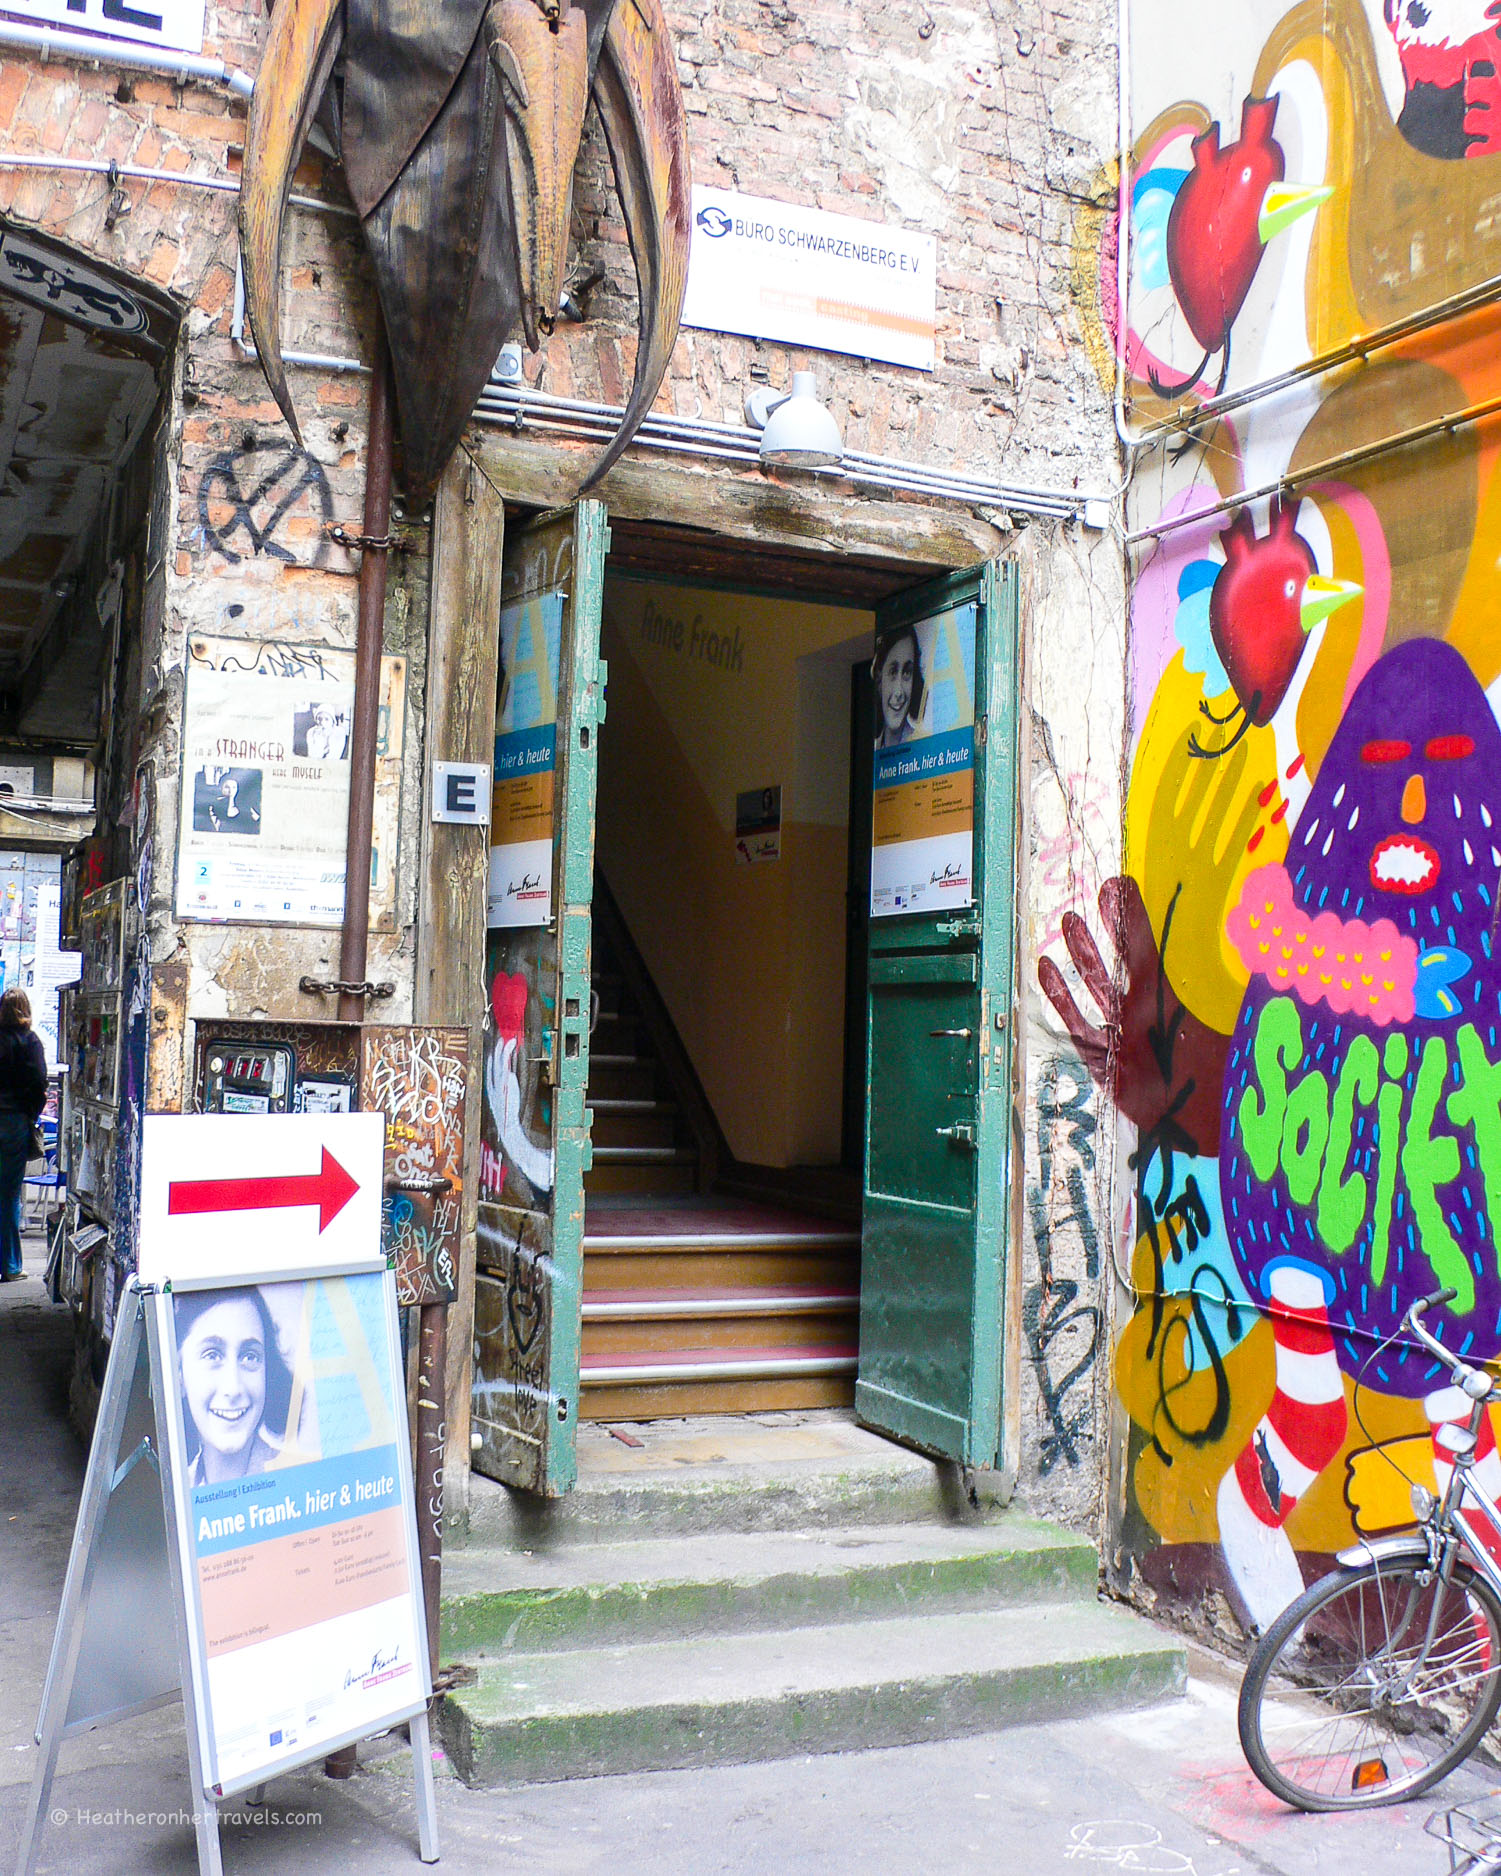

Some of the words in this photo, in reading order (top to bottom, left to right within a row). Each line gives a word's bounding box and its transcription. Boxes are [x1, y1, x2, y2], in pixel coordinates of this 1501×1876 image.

[779, 227, 896, 268] SCHWARZENBERG
[642, 598, 685, 652] Anne
[689, 613, 745, 673] Frank
[216, 738, 285, 762] STRANGER
[500, 753, 516, 769] hier
[517, 752, 524, 767] &
[526, 746, 551, 763] heute
[879, 765, 897, 780] Anne
[898, 757, 921, 776] Frank.
[921, 753, 937, 770] hier
[938, 751, 944, 767] &
[945, 746, 969, 765] heute
[292, 765, 323, 780] MYSELF
[446, 774, 476, 813] E
[200, 866, 208, 876] 2
[195, 1487, 237, 1505] Ausstellung
[242, 1479, 277, 1495] Exhibition
[198, 1513, 246, 1541] Anne
[249, 1496, 301, 1529] Frank.
[305, 1489, 337, 1515] hier
[340, 1484, 351, 1507] &
[355, 1475, 394, 1502] heute
